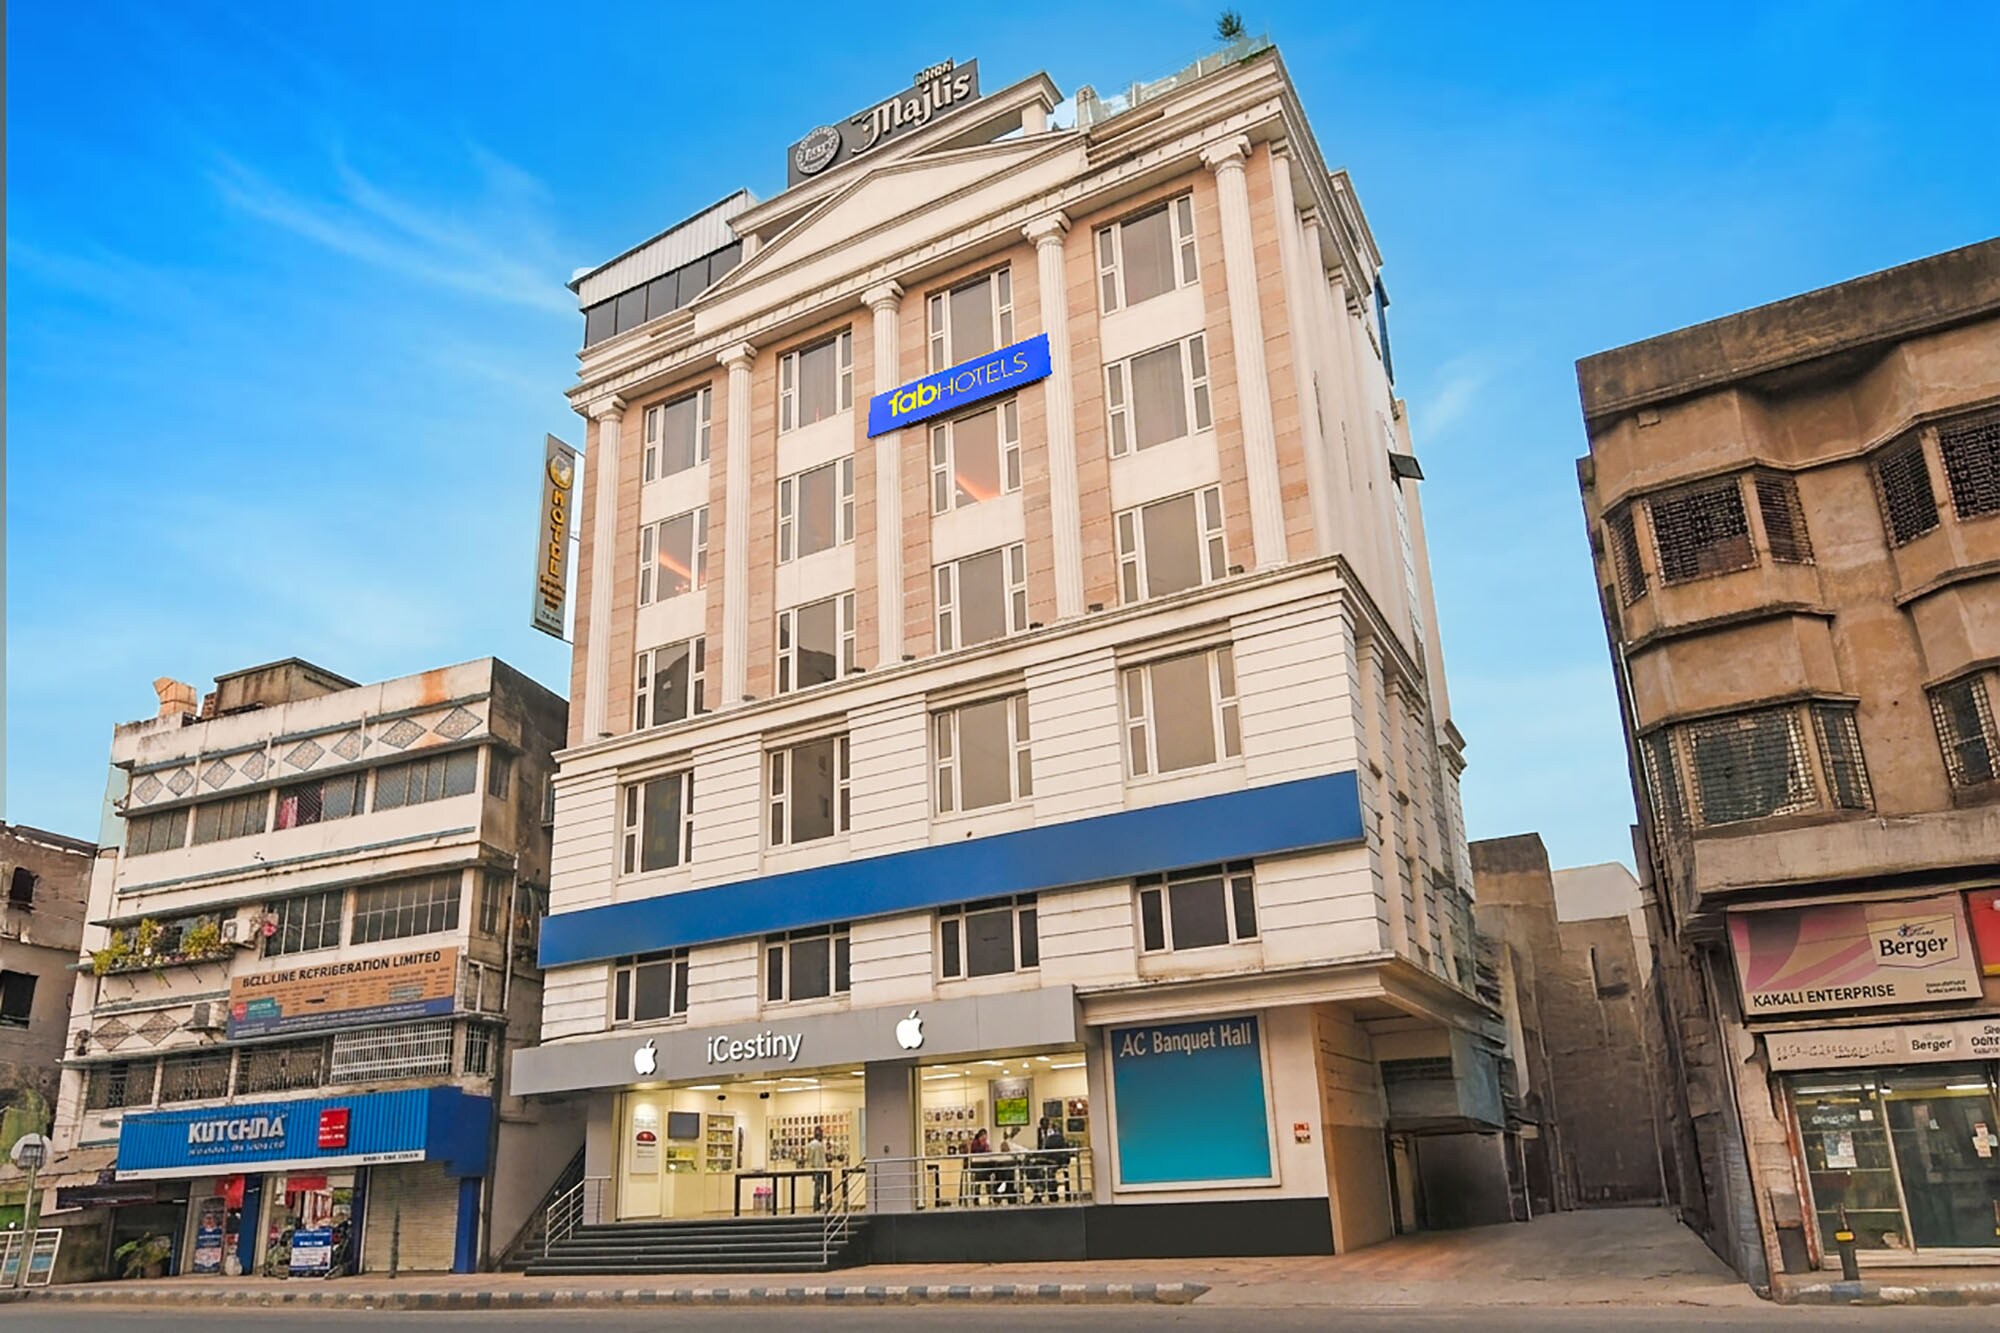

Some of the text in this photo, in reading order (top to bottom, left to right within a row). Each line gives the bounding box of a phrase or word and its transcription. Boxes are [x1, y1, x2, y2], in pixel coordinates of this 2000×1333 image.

[851, 73, 971, 155] Majlis
[393, 950, 441, 968] LIMITED
[1879, 937, 1948, 958] Berger
[1753, 983, 1896, 1007] KAKALI ENTERPRISE
[707, 1030, 803, 1064] iCestiny
[1119, 1022, 1251, 1058] AC Banquet Hall
[1911, 1039, 1953, 1052] Berger
